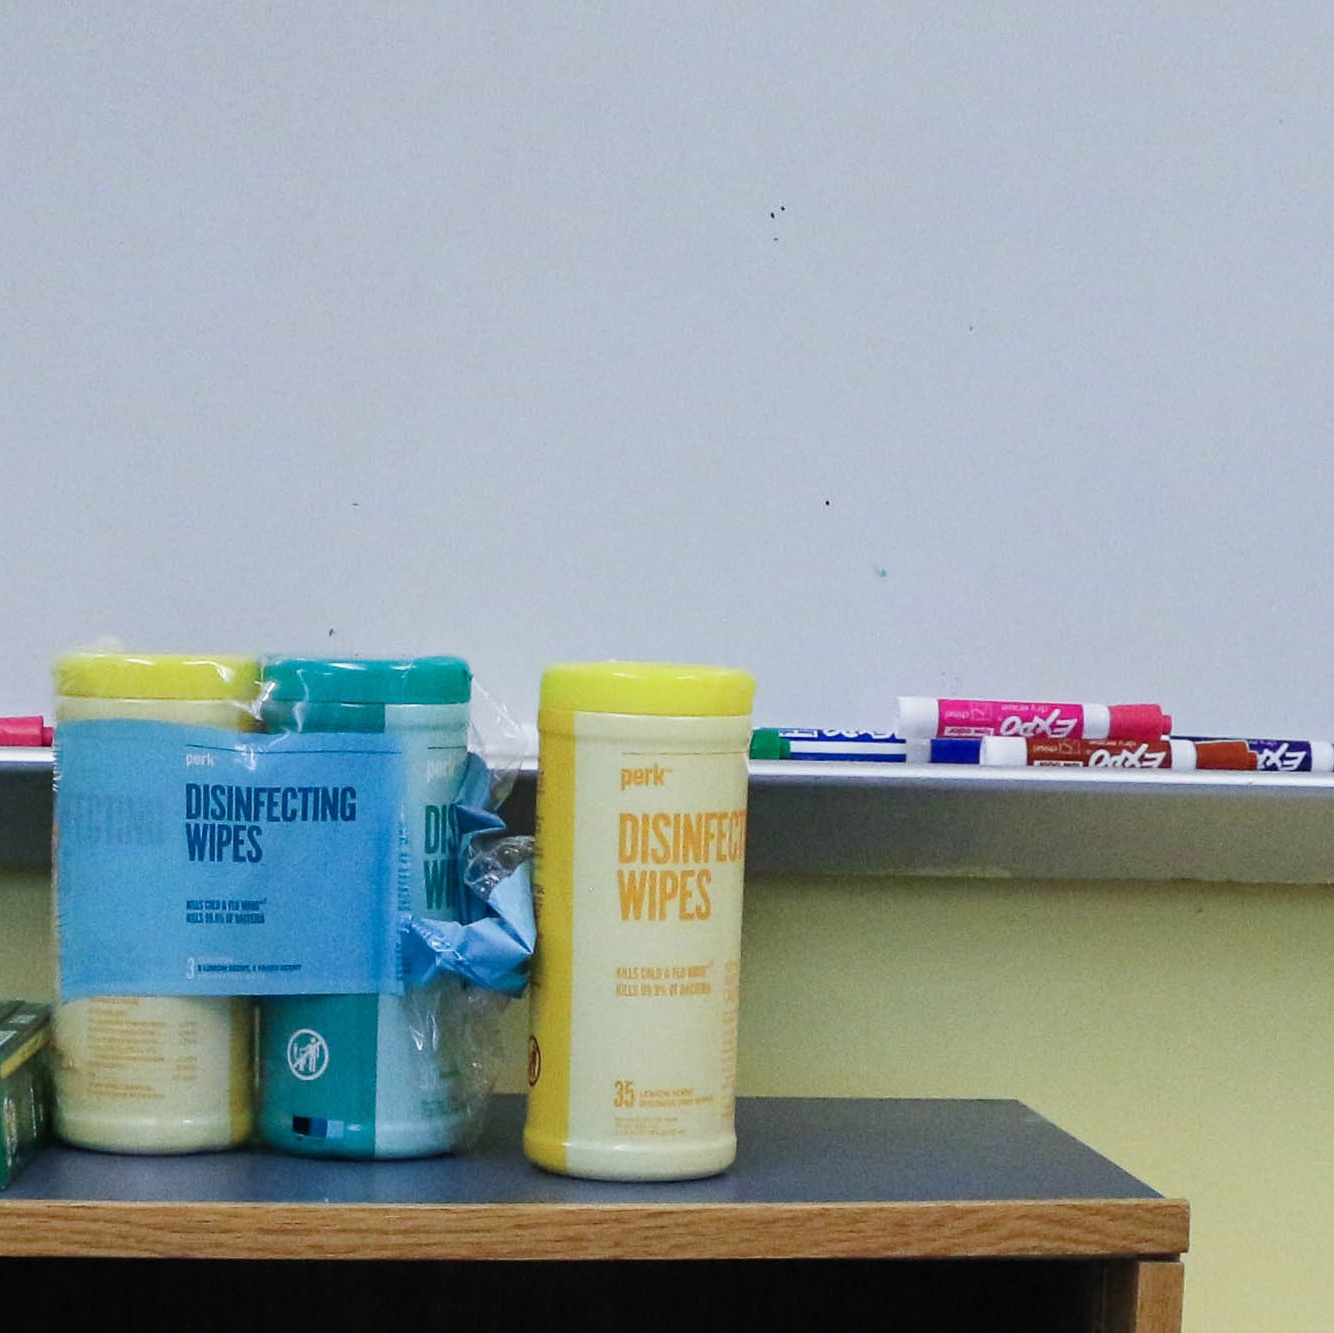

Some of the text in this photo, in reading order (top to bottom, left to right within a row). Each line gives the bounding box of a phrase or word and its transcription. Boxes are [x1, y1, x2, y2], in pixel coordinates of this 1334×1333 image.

[999, 708, 1079, 740] EXPO
[186, 753, 214, 767] perk
[1088, 743, 1166, 769] EXPO
[620, 763, 665, 791] perk
[185, 782, 357, 823] DISINFECTING
[185, 823, 263, 864] WIPES
[617, 869, 712, 922] WIPES
[616, 967, 640, 979] KILLS
[641, 966, 662, 979] COLD
[614, 1081, 635, 1108] 35
